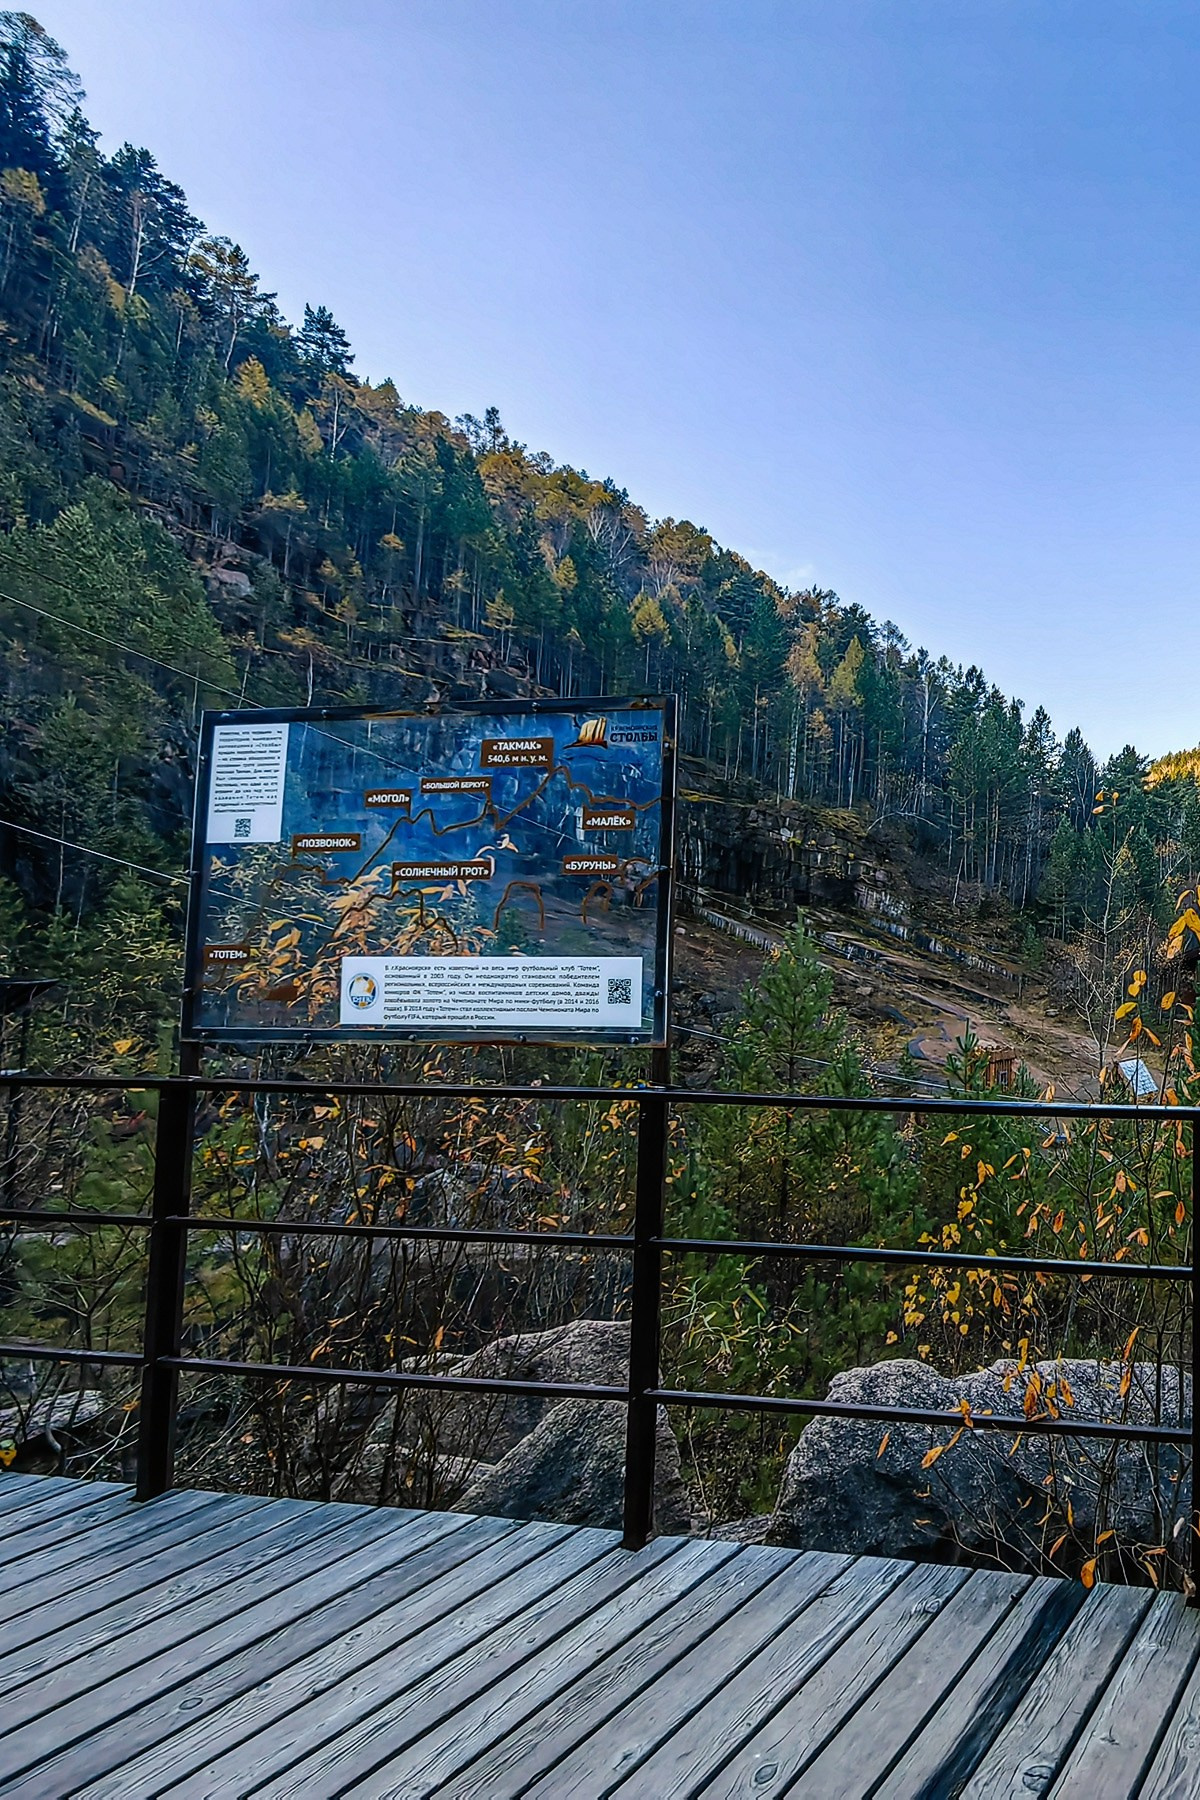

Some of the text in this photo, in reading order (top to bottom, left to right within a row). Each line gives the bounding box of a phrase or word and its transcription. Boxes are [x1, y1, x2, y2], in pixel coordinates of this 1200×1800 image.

[610, 732, 658, 742] СТОЛБЫ
[492, 740, 542, 750] «ТАКМАК»
[487, 754, 510, 763] 540,6
[367, 794, 410, 803] «МОГОЛ»
[586, 815, 631, 827] «МАЛЁК»
[296, 838, 357, 848] «ПОЗВОНОК»
[566, 861, 617, 870] «БУРУНЫ»
[395, 866, 489, 877] «СОЛНЕЧНЫЙ ГРОТ»
[209, 950, 247, 960] «ТОТЕМ»
